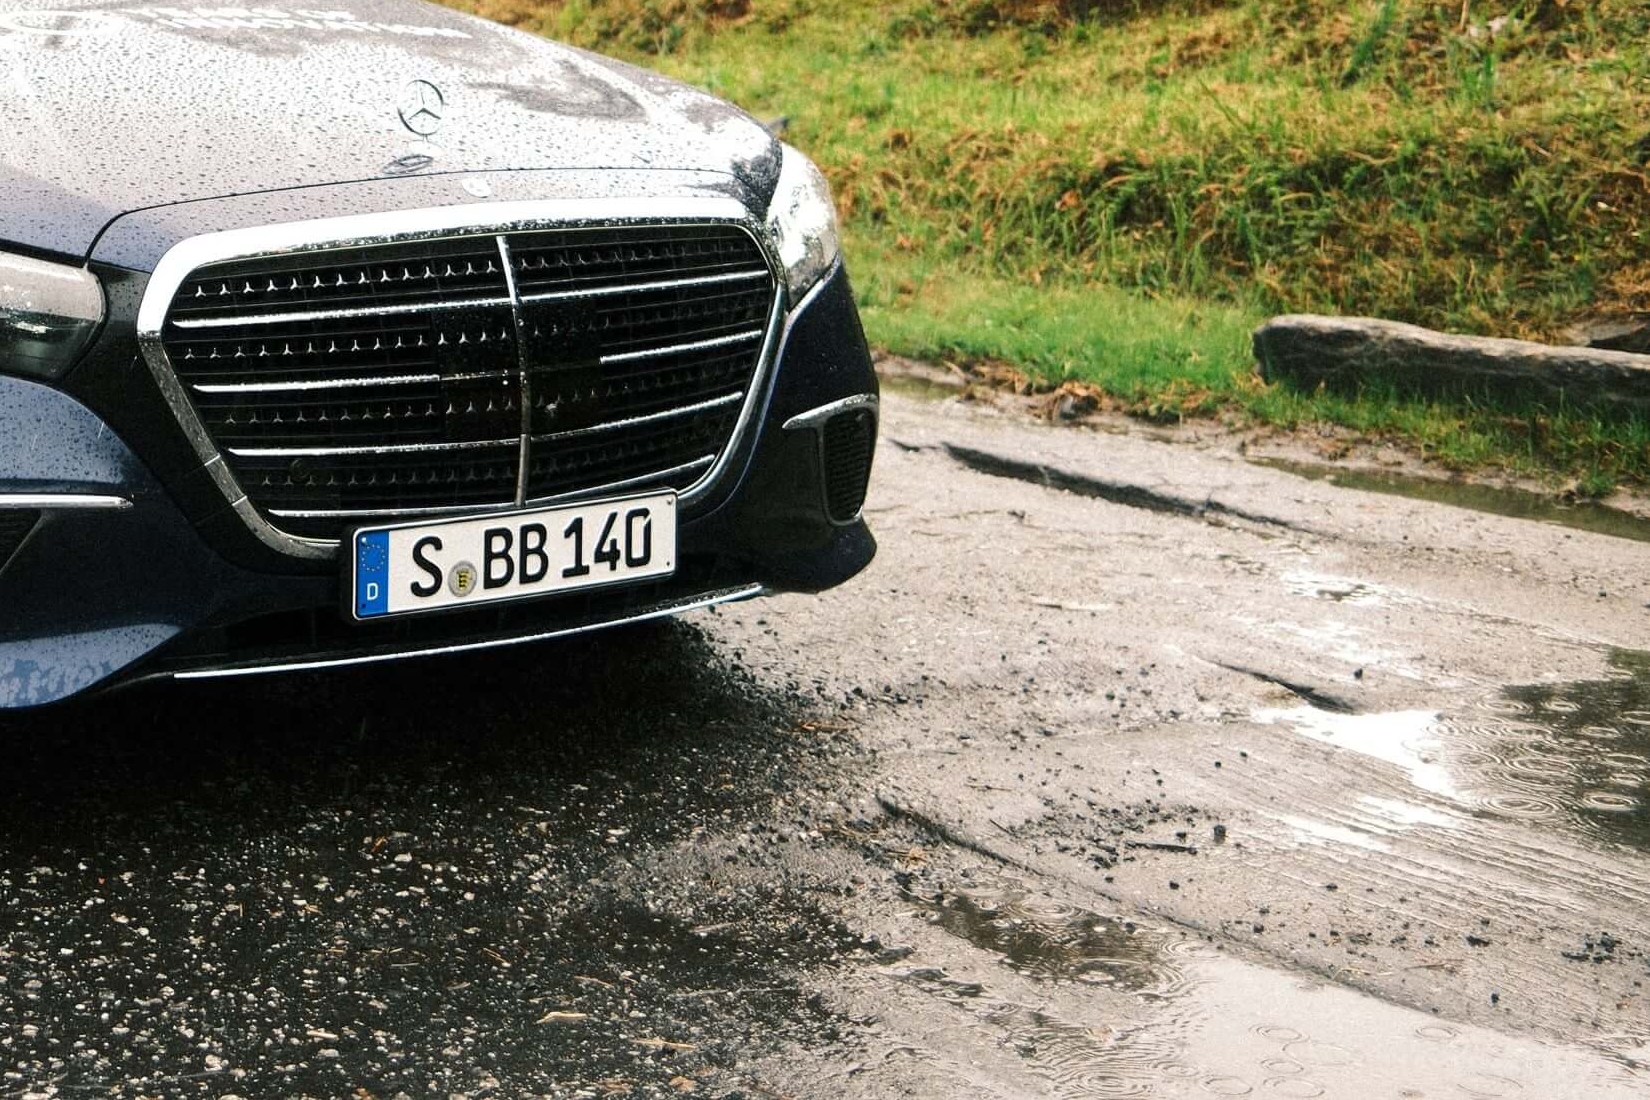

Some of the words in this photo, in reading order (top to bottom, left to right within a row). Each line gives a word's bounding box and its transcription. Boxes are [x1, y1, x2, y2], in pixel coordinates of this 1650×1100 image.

[410, 536, 444, 598] S
[483, 522, 550, 590] BB
[561, 507, 652, 579] 140
[366, 582, 379, 600] D
